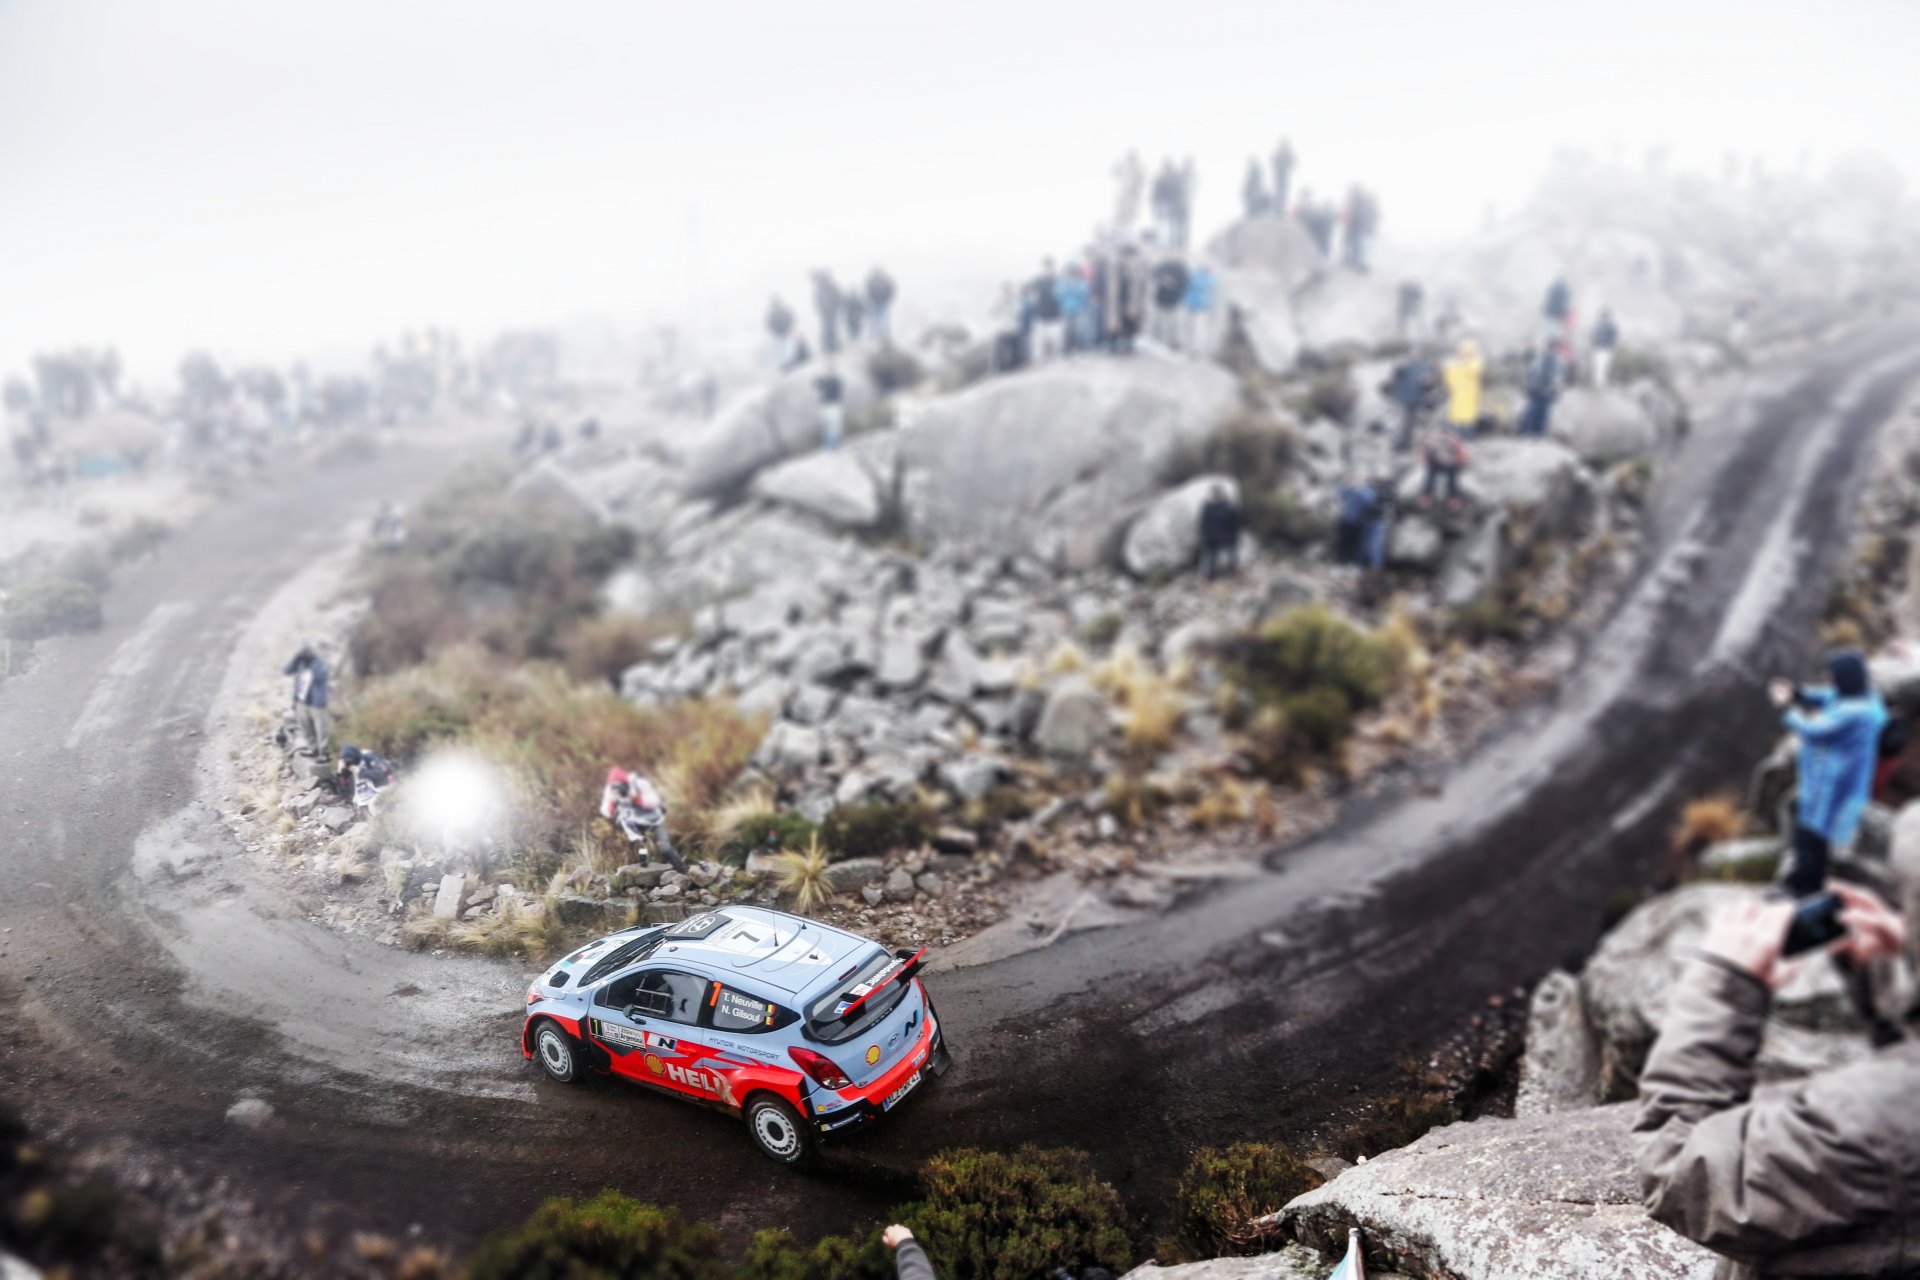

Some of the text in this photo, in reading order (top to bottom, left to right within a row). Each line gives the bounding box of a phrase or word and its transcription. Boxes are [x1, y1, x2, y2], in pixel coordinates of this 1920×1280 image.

[732, 931, 760, 943] 7
[723, 992, 763, 1011] T. Neuville
[721, 1005, 761, 1023] N. Gilsoul
[709, 1036, 780, 1060] HYUNDAI MOTORSPORT
